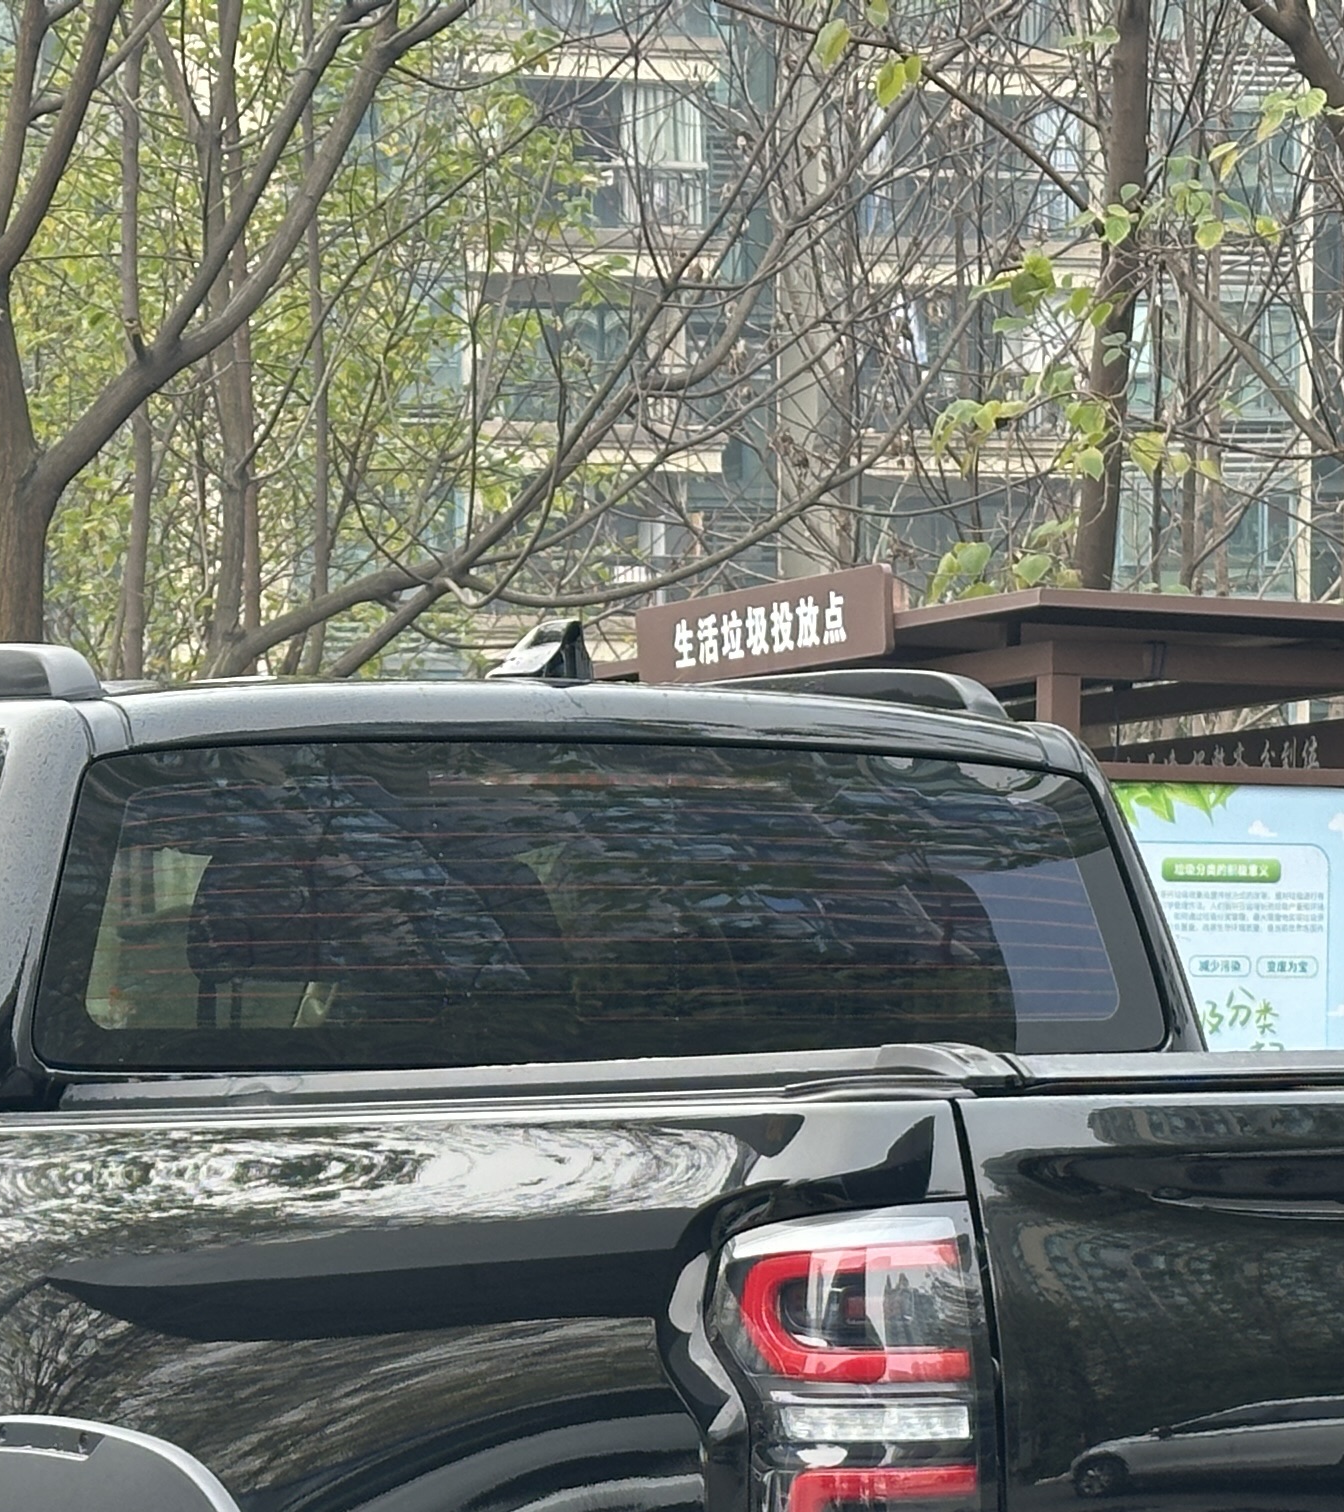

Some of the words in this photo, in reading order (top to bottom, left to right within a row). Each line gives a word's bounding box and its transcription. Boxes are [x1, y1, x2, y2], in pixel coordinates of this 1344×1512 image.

[674, 590, 848, 669] 生活垃圾投放点
[1198, 959, 1242, 973] 减少污染
